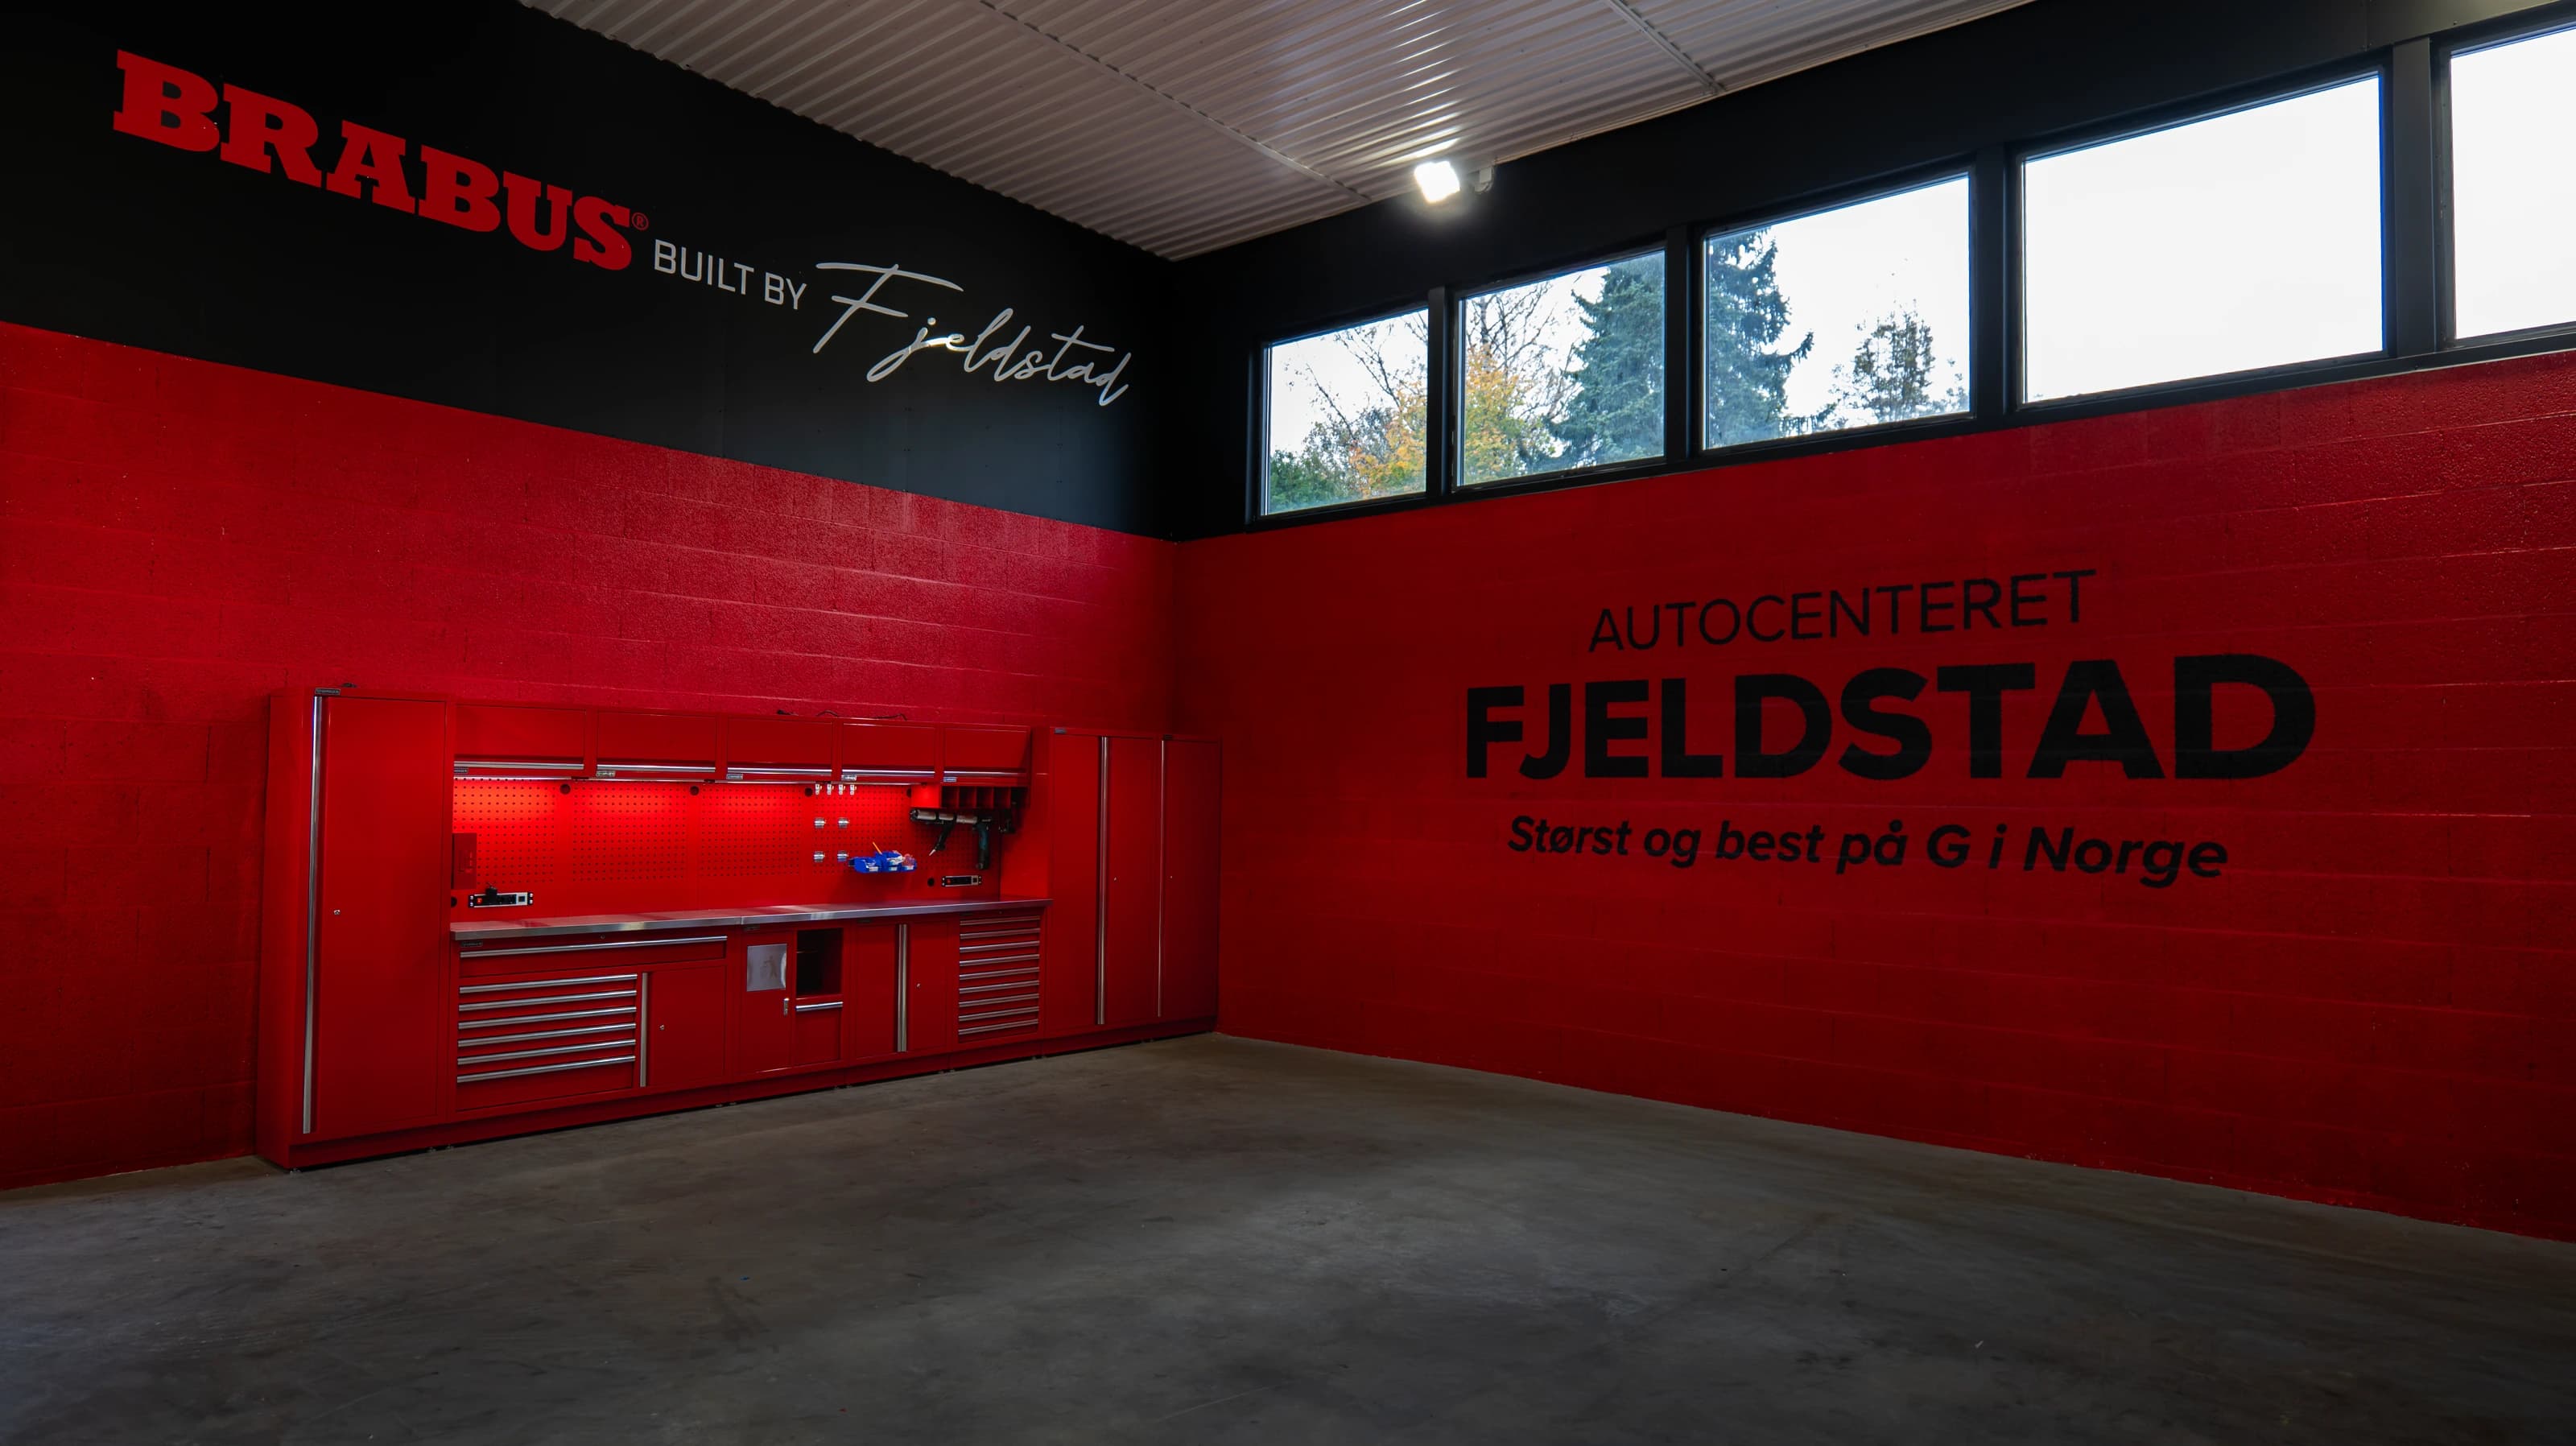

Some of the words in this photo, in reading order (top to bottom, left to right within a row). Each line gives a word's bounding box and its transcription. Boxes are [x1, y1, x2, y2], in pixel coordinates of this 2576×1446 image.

[654, 238, 755, 295] BUILT
[764, 271, 807, 310] BY
[812, 262, 1132, 407] Fjeldstad
[1588, 568, 2096, 653] AUTOCENTERET
[1465, 653, 2317, 781] FJELDSTAD
[1508, 815, 1633, 856] Størst
[1643, 828, 1701, 869] og
[1715, 820, 1825, 863] best
[1835, 819, 1908, 874] på
[1926, 824, 1971, 869] G
[1988, 823, 2007, 870] i
[2023, 826, 2228, 889] Norge
